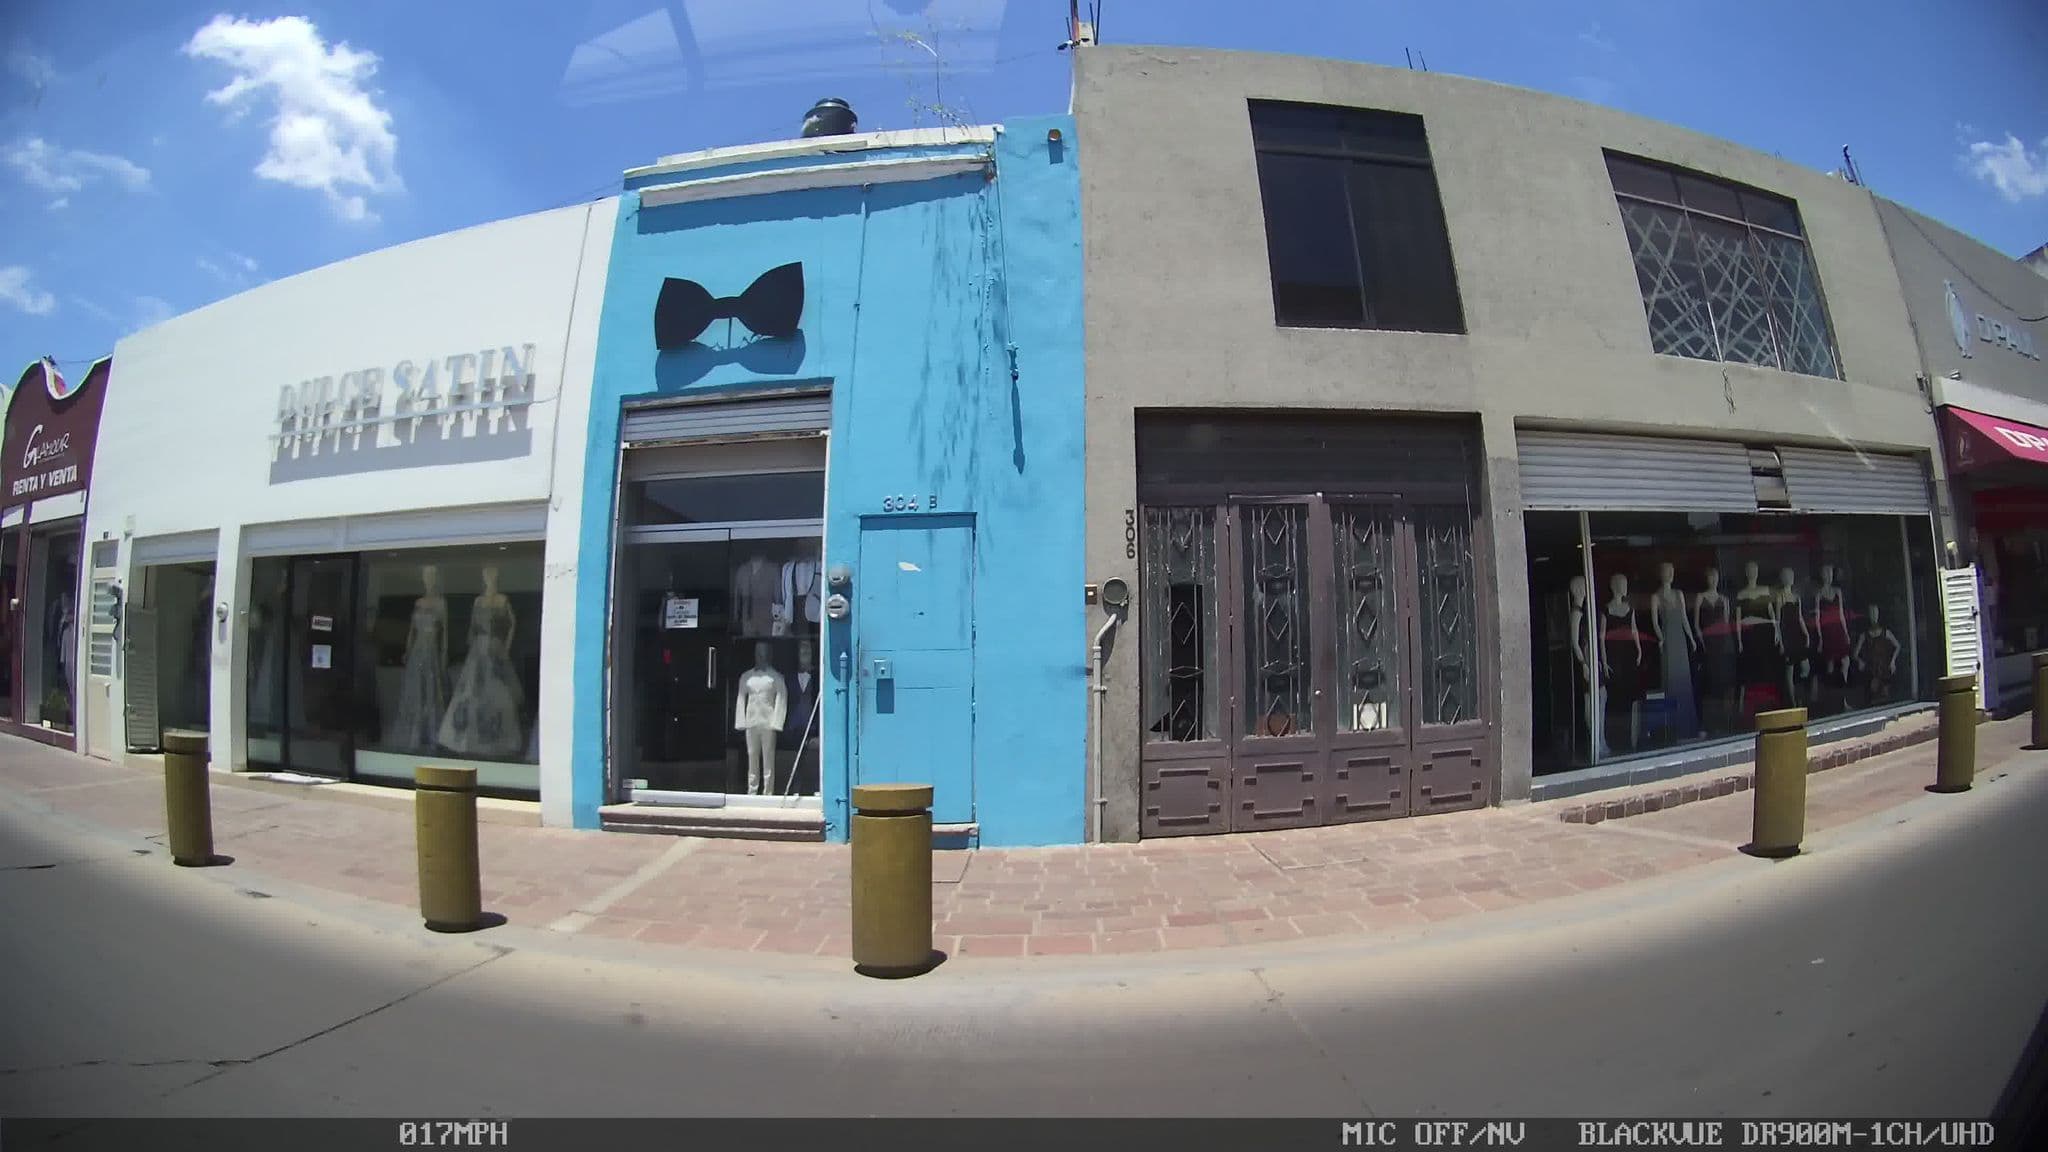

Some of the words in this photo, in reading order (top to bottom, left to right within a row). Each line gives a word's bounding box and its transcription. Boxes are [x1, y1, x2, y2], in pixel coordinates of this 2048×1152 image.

[279, 368, 385, 422] DULCE
[393, 343, 537, 402] SATIN
[1993, 426, 2048, 452] DP
[12, 476, 39, 497] RENTA
[40, 472, 48, 490] Y
[48, 464, 78, 488] VENTA
[883, 494, 919, 513] 304
[929, 495, 938, 509] B
[1125, 509, 1136, 560] 306
